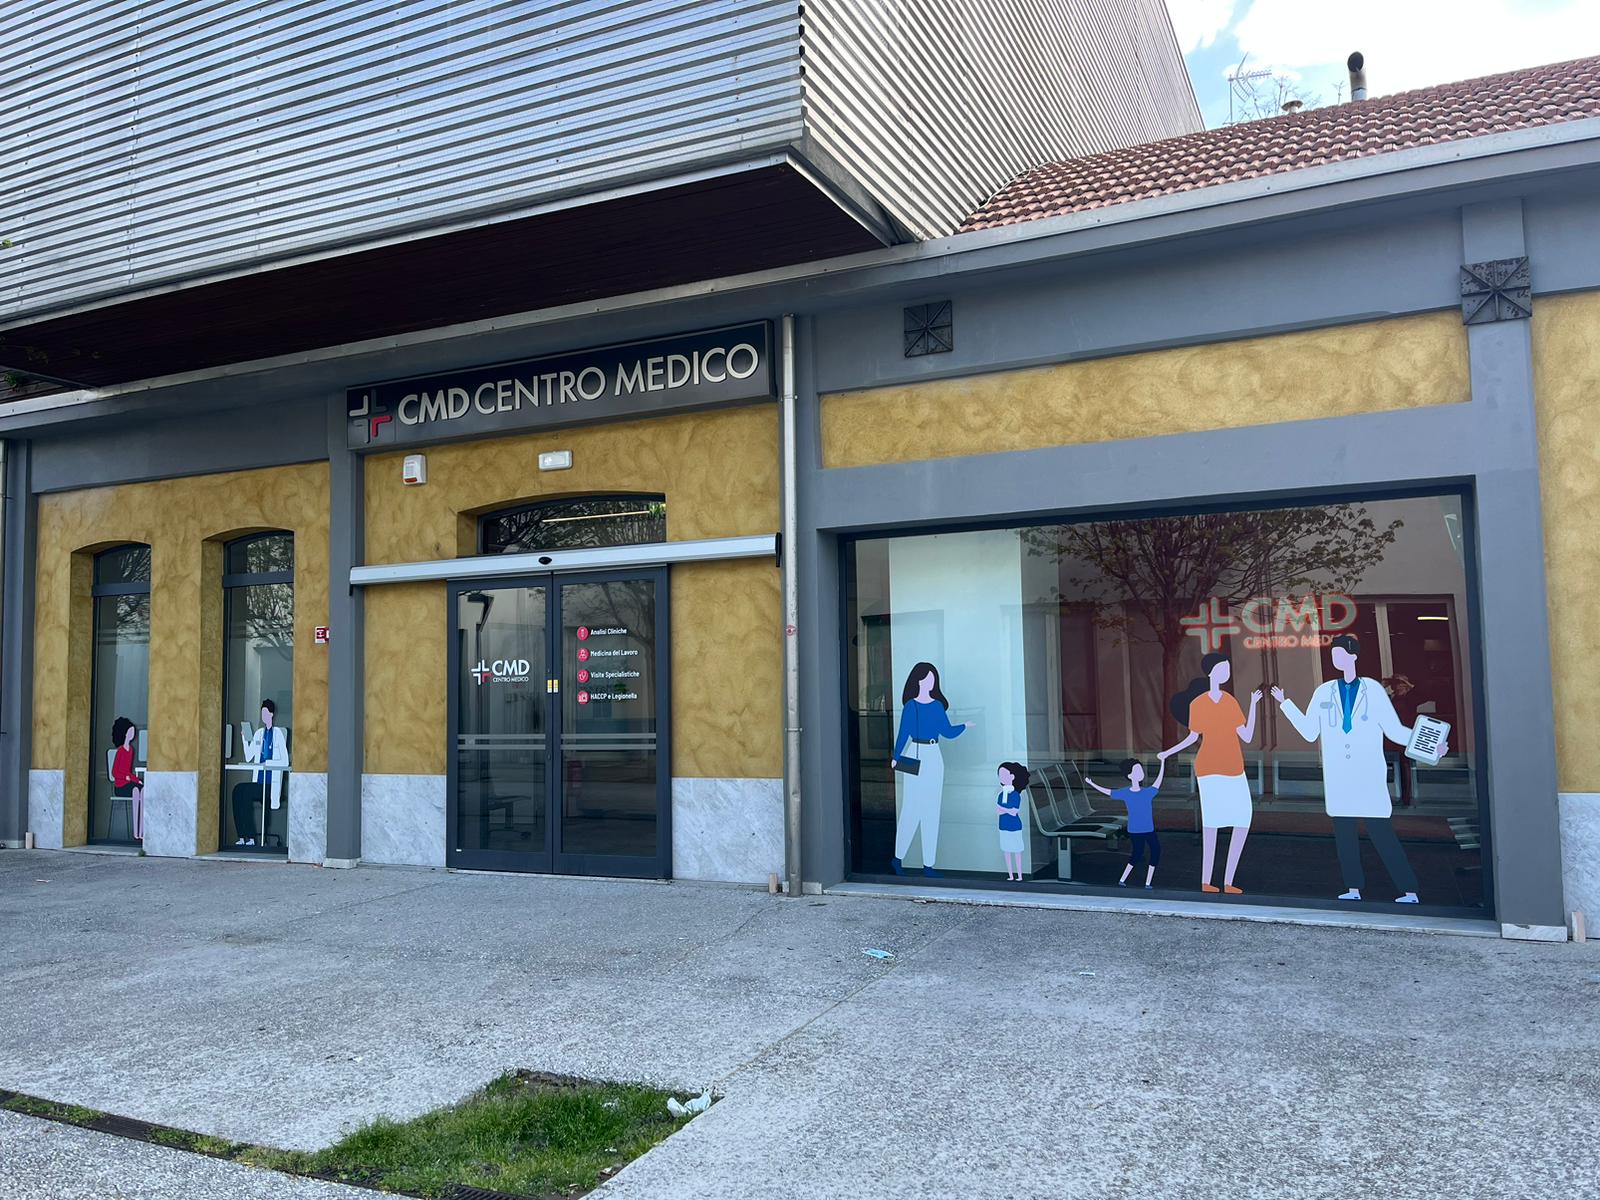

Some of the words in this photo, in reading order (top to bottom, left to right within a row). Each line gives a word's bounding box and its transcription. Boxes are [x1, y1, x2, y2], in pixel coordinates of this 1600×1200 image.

[398, 387, 470, 425] CMD
[474, 367, 606, 415] CENTRO
[614, 343, 759, 396] MEDICO
[1242, 592, 1356, 633] CMD
[1243, 635, 1300, 648] CENTRO
[492, 659, 530, 676] CMD
[605, 671, 640, 679] Specialistiche
[612, 692, 638, 700] Legionella
